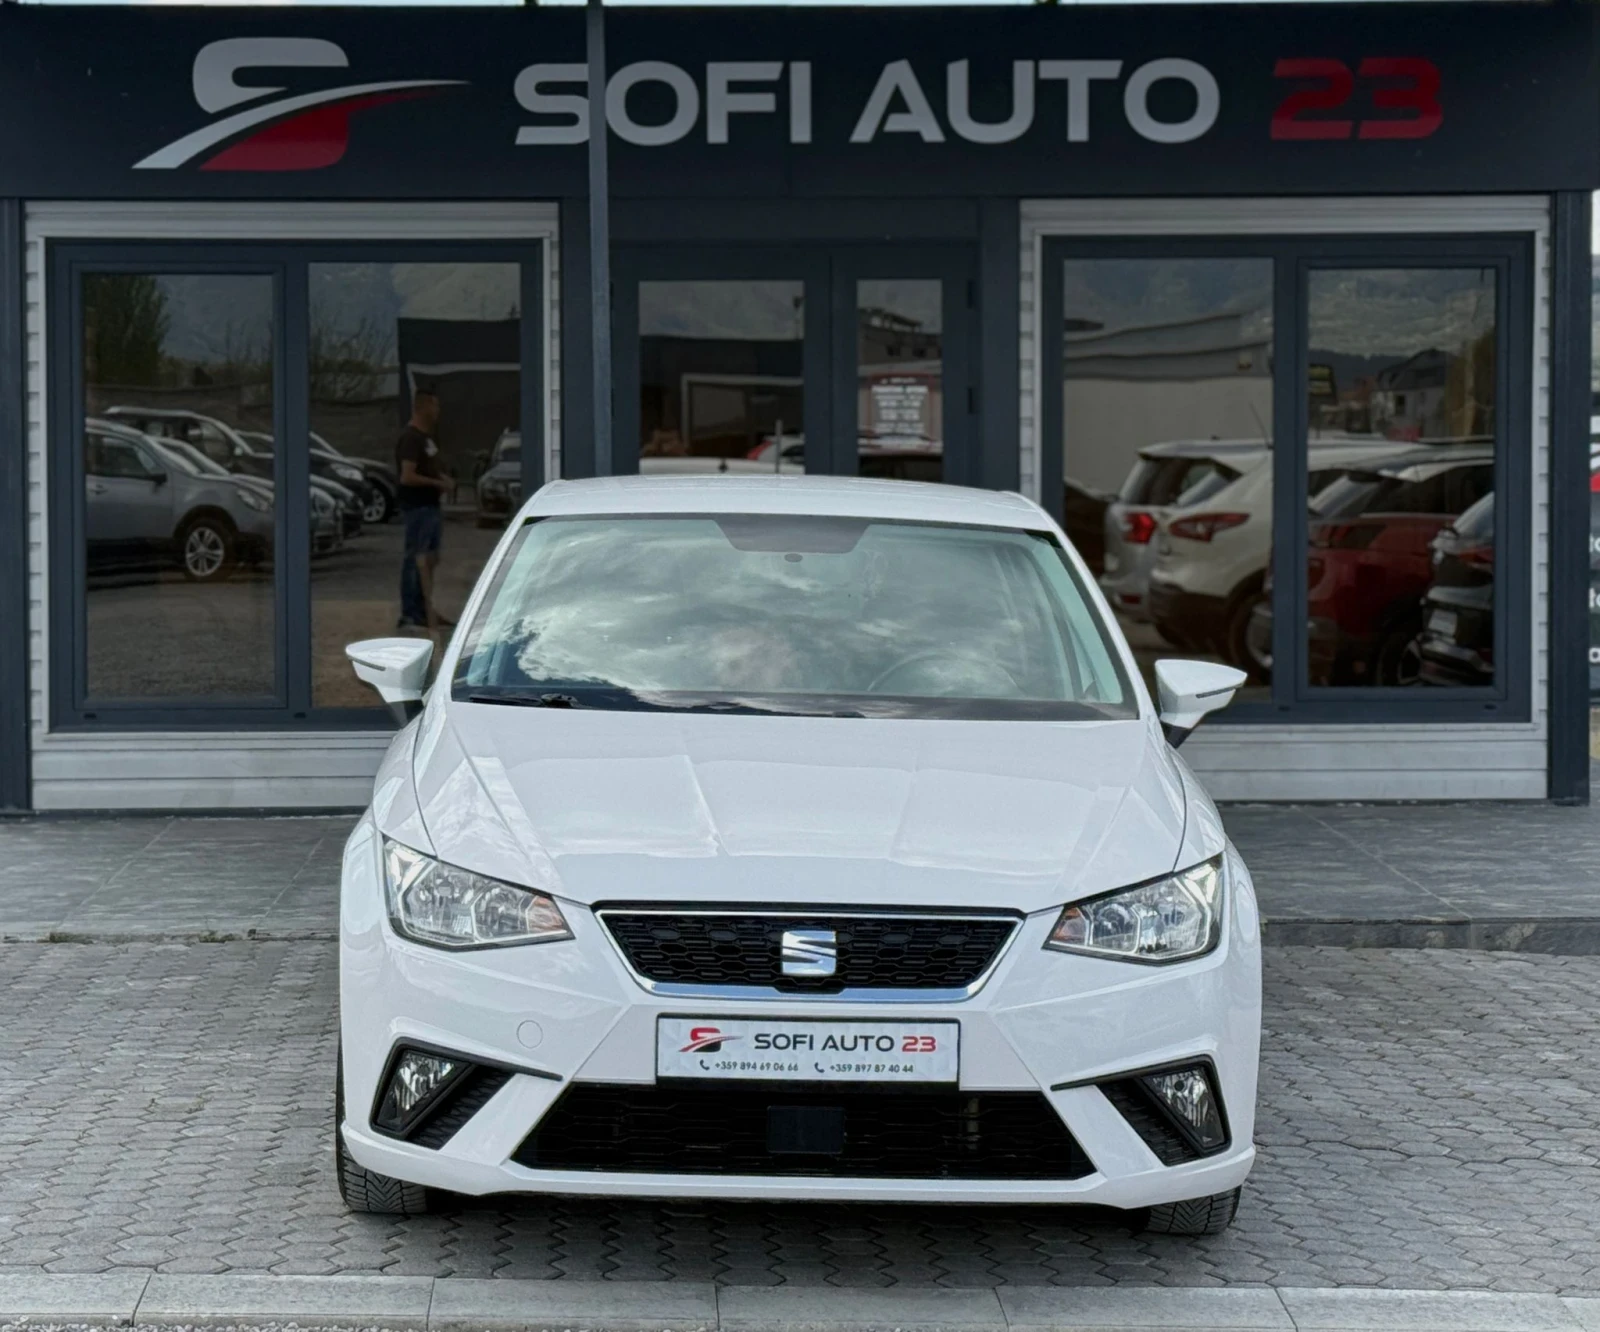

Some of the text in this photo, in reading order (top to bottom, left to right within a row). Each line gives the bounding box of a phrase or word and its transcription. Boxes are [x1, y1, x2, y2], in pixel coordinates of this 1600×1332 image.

[513, 57, 1444, 147] SOFI AUTO 23
[754, 1033, 937, 1052] SOFI AUTO 23
[715, 1061, 799, 1072] +359 894 69 06 66
[830, 1063, 914, 1073] +359 897 87 40 44
